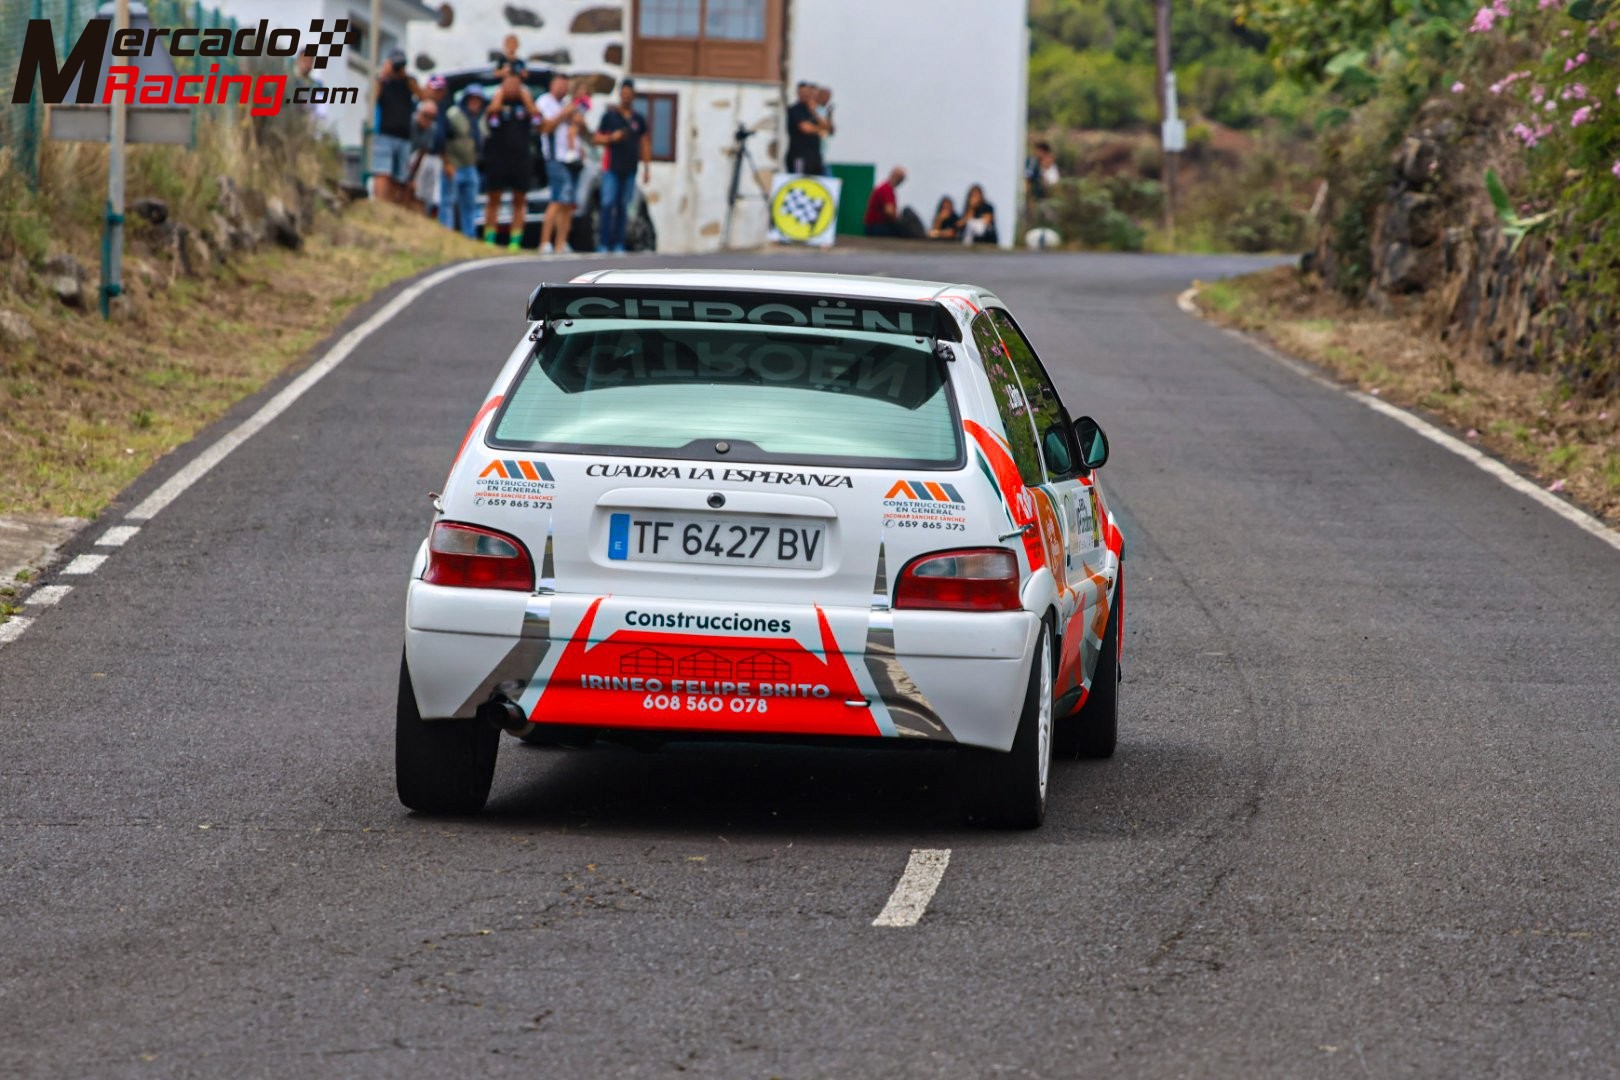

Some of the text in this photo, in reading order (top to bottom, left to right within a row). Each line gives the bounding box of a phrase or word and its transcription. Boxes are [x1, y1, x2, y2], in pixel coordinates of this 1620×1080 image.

[585, 463, 854, 488] CUADRA LA ESPERANZA
[476, 480, 555, 489] CONSTRUCCIONES
[501, 486, 542, 494] GENERAL
[510, 500, 529, 508] 865
[883, 501, 966, 511] CONSTRUCCIONES
[898, 520, 966, 531] 659 865 373
[614, 541, 622, 550] E
[633, 521, 821, 562] TF 6427 BV
[625, 610, 792, 633] Construcciones
[580, 674, 831, 699] IRINEO FELIPE BRITO
[642, 694, 768, 714] 608 560 078
